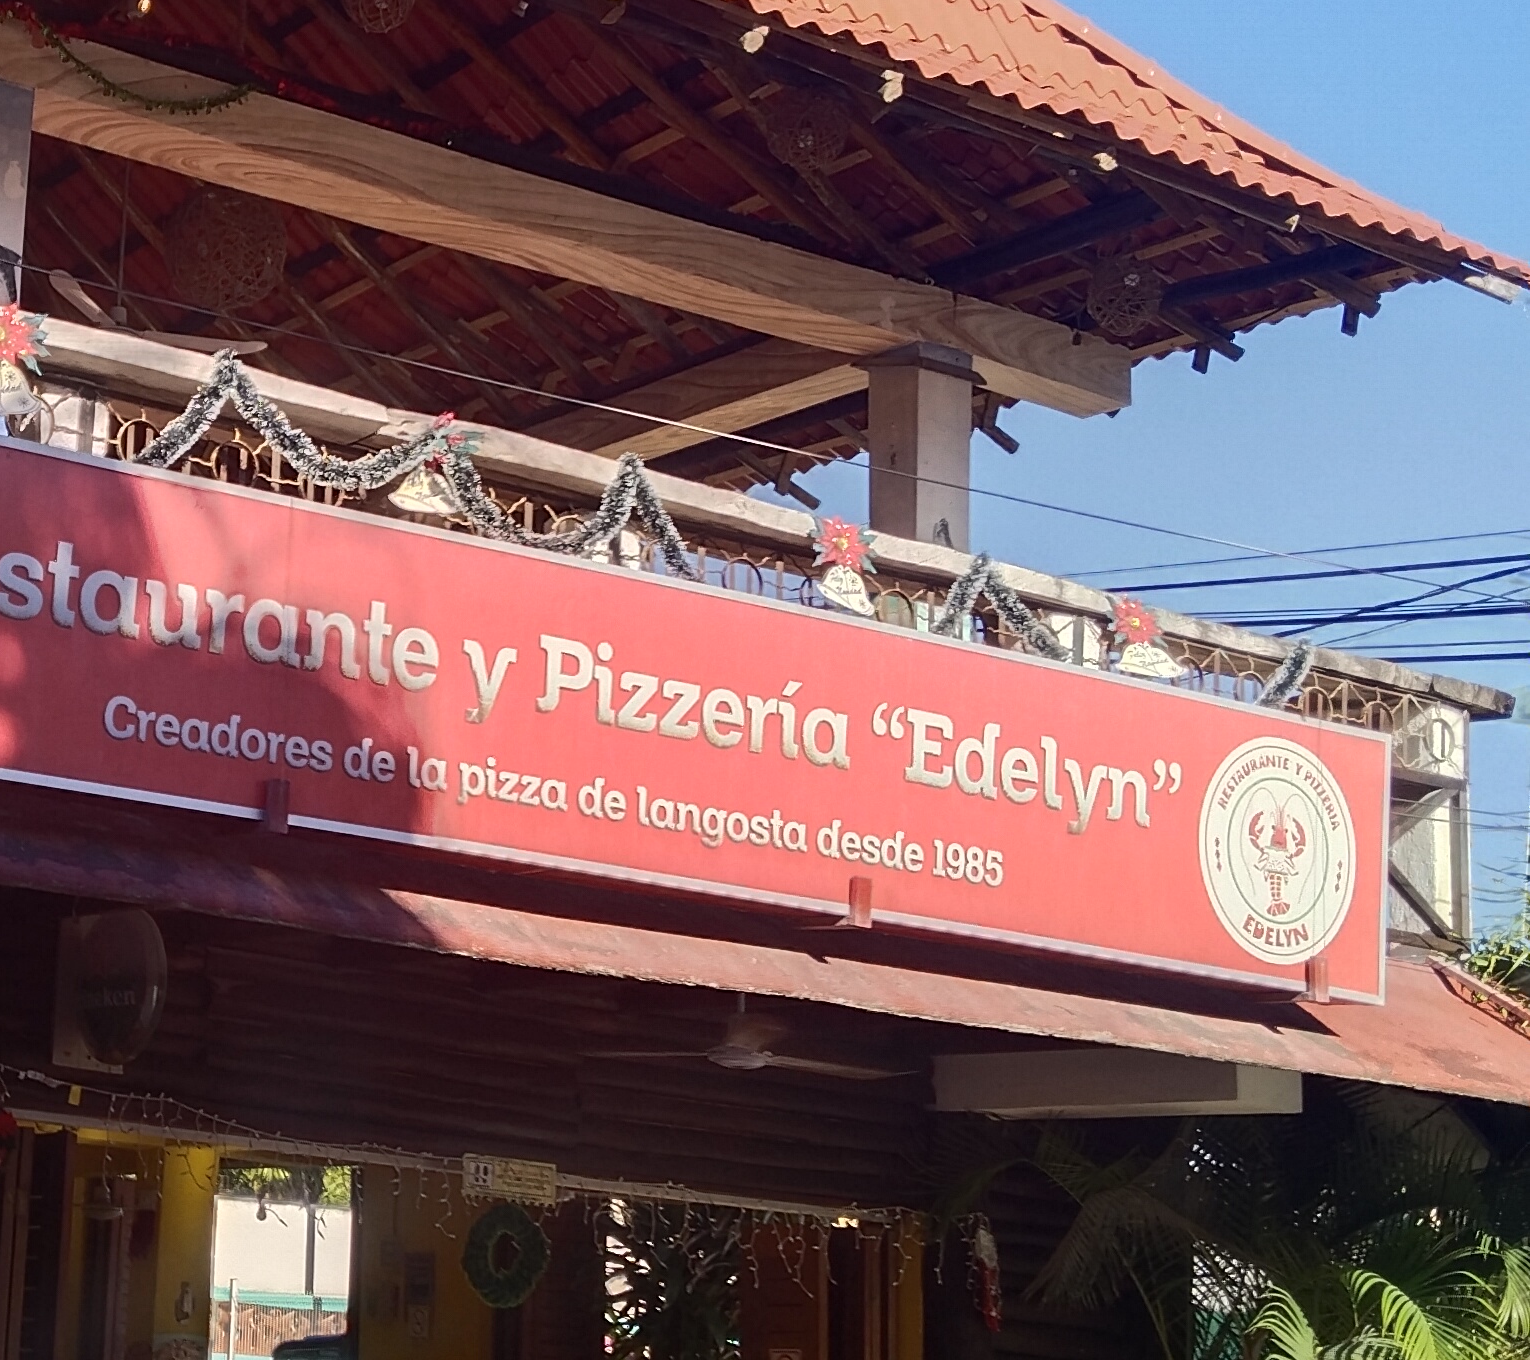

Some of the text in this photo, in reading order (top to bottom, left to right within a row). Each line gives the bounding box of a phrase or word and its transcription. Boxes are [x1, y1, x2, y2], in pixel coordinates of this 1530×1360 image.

[104, 694, 1004, 887] Creadores de la pizza de langosta desde 1985
[461, 637, 517, 723] y
[535, 633, 850, 770] Pizzería
[870, 701, 1182, 835] “Edelyn”
[1217, 754, 1341, 832] RESTAURANTE Y PIZZERIA
[1242, 913, 1310, 947] EDELYN
